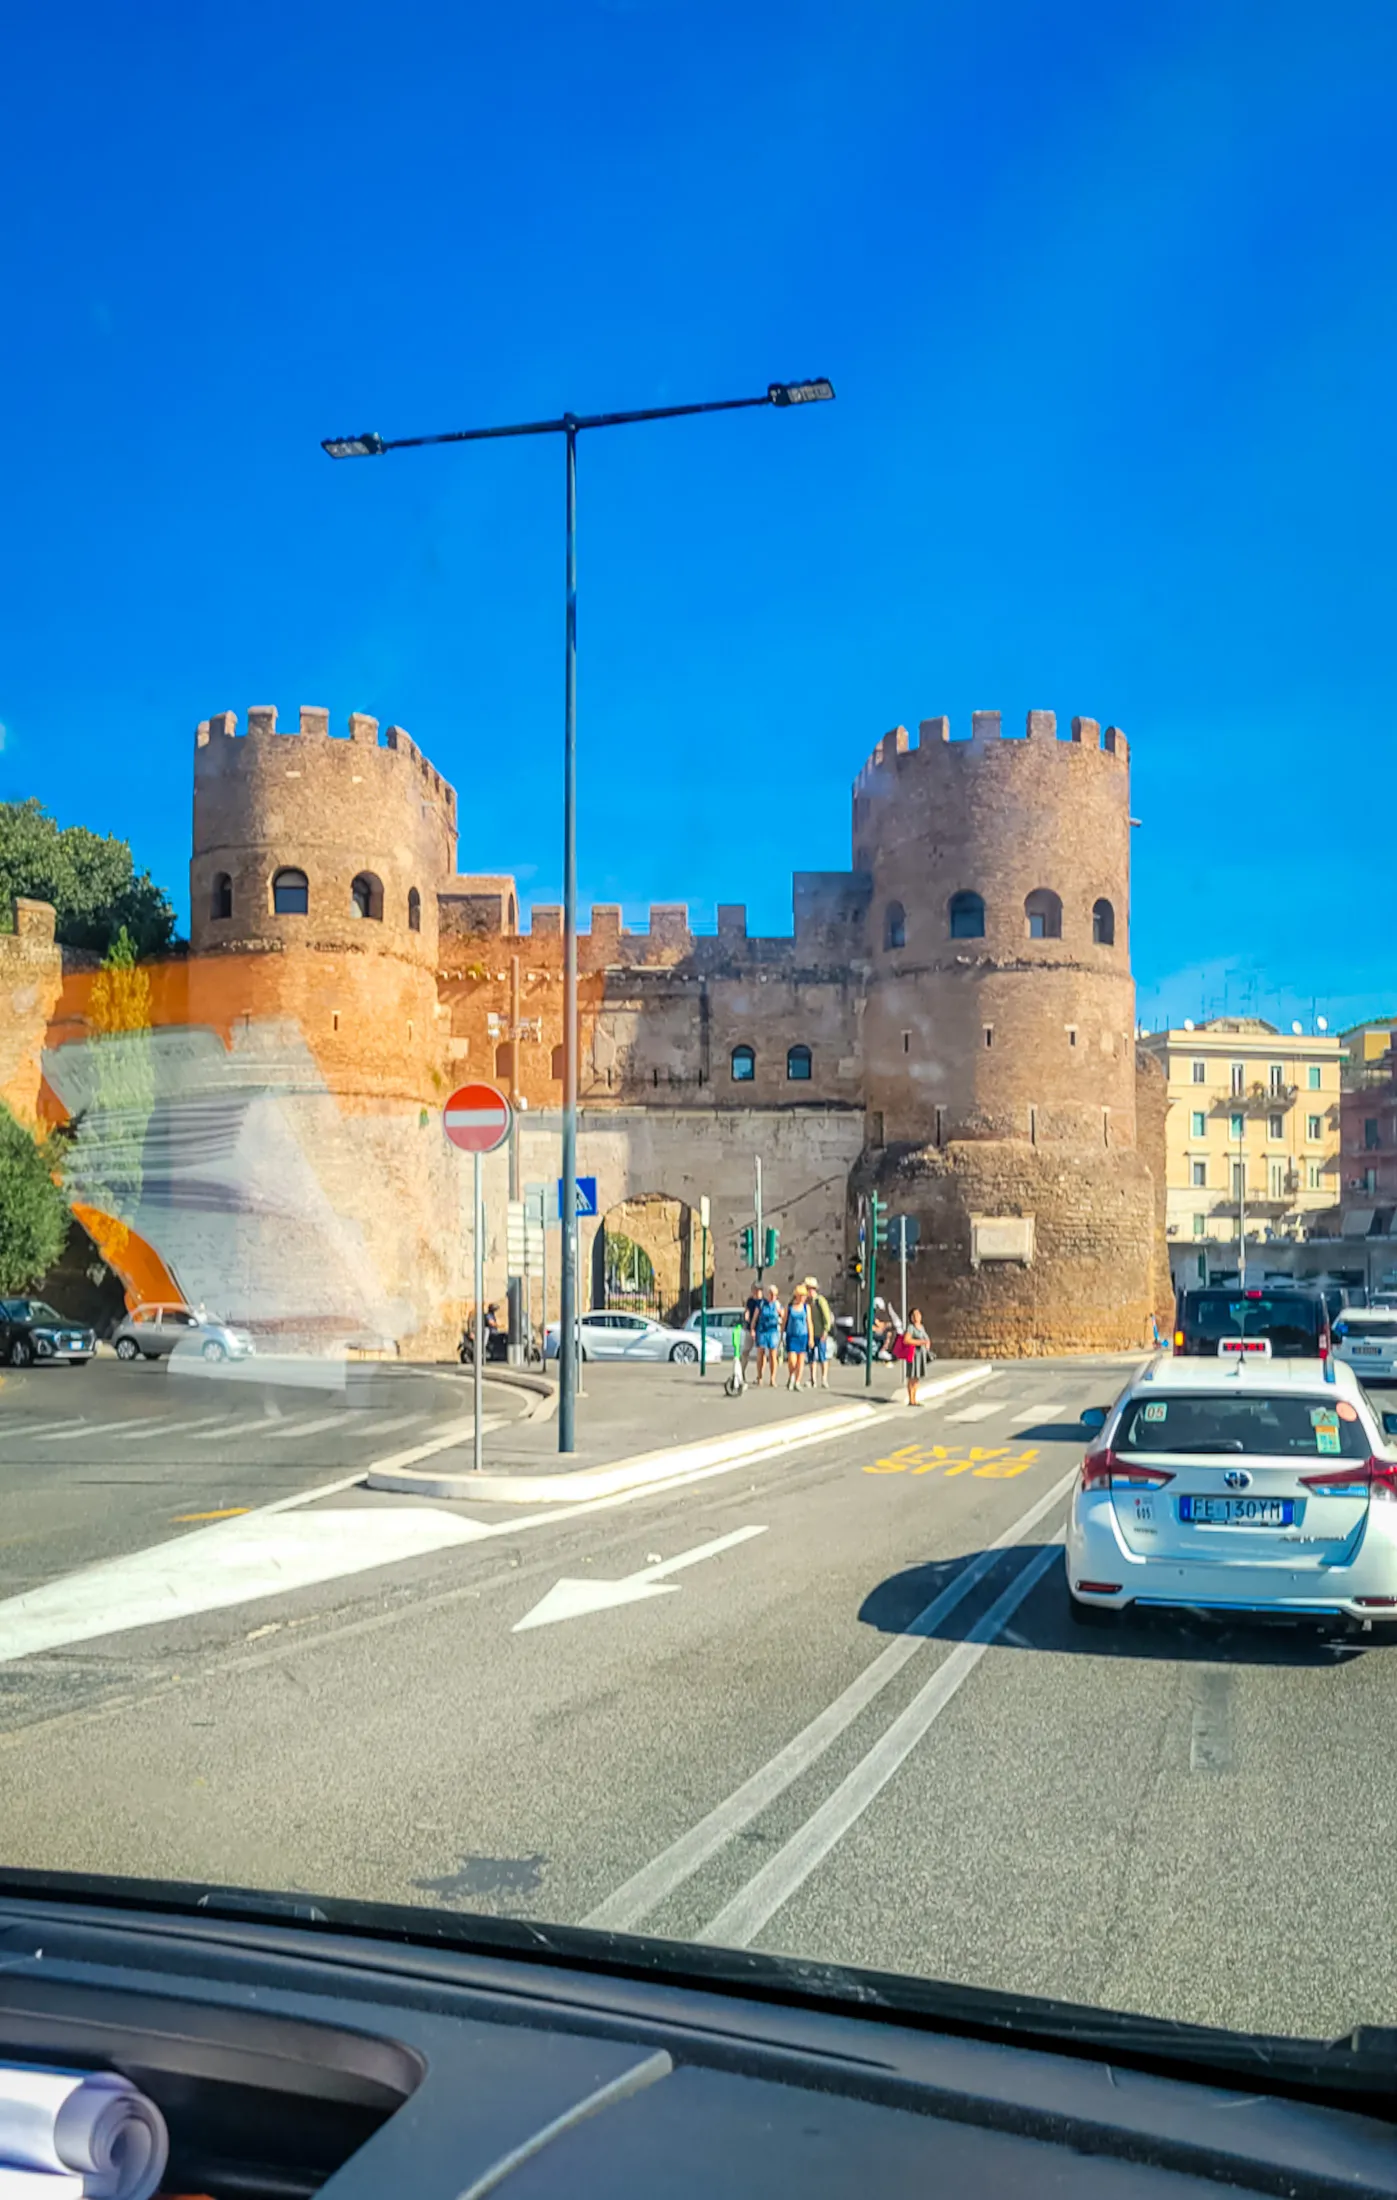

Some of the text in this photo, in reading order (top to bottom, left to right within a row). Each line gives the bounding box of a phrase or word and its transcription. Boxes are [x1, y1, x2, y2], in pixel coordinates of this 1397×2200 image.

[891, 1443, 1041, 1463] TAXI
[861, 1458, 1031, 1479] BUS
[1193, 1497, 1281, 1519] FE 130YM
